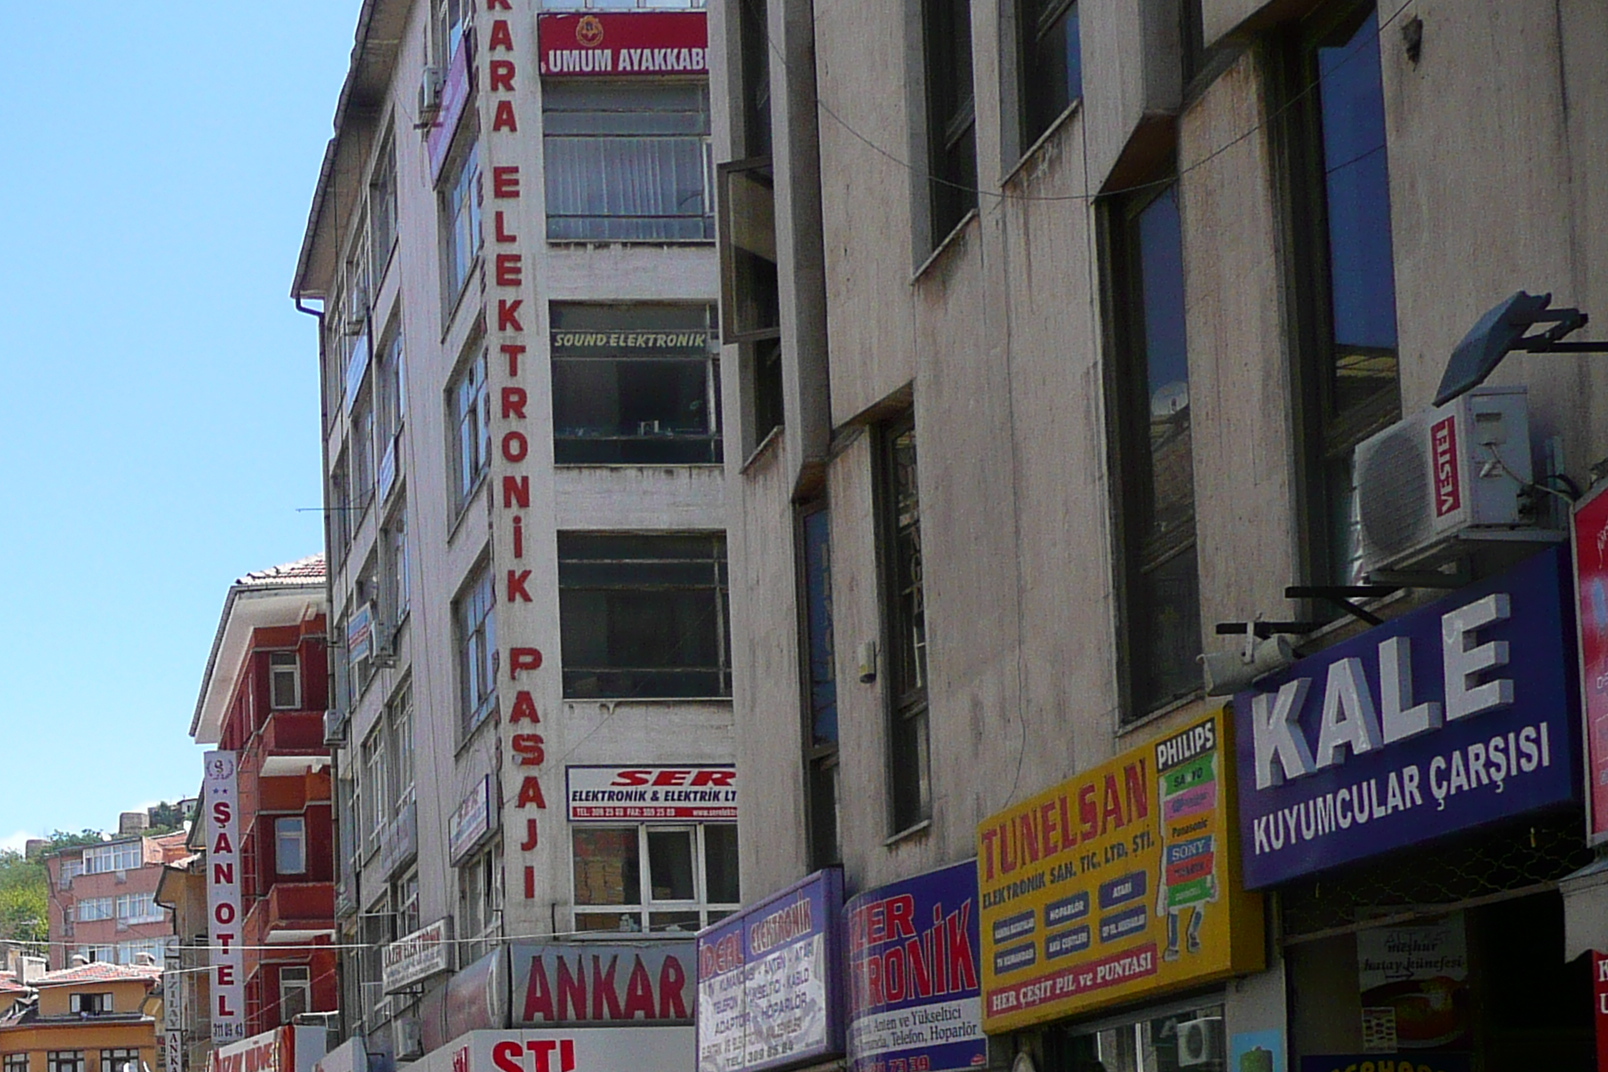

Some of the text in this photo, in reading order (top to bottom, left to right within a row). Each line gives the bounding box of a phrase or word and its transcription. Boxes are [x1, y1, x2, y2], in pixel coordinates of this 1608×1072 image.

[548, 49, 612, 72] UMUM
[555, 333, 606, 347] SOUND
[493, 166, 533, 603] ELEKTRONİK
[1435, 419, 1455, 513] VESTEL
[1252, 593, 1514, 791] KALE
[509, 647, 546, 899] PASAJI
[1156, 721, 1214, 770] PHILIPS
[571, 787, 647, 803] ELEKTRONİK
[650, 790, 660, 802] &
[664, 787, 722, 802] ELEKTRİK
[610, 770, 737, 787] SER
[1253, 721, 1551, 855] KUYUMCULAR ÇARŞISI
[981, 757, 1149, 883] TUNELSAN
[1172, 839, 1206, 861] SONY
[214, 913, 236, 1017] OTEL
[522, 953, 695, 1022] ANKAR
[992, 989, 1017, 1012] HER
[1019, 977, 1053, 1009] ÇEŞİT
[1079, 971, 1093, 987] ve
[1095, 951, 1152, 984] PUNTASI
[899, 1014, 910, 1028] ve
[911, 1005, 962, 1026] Yükseltici
[930, 1020, 977, 1043] Hoparlör
